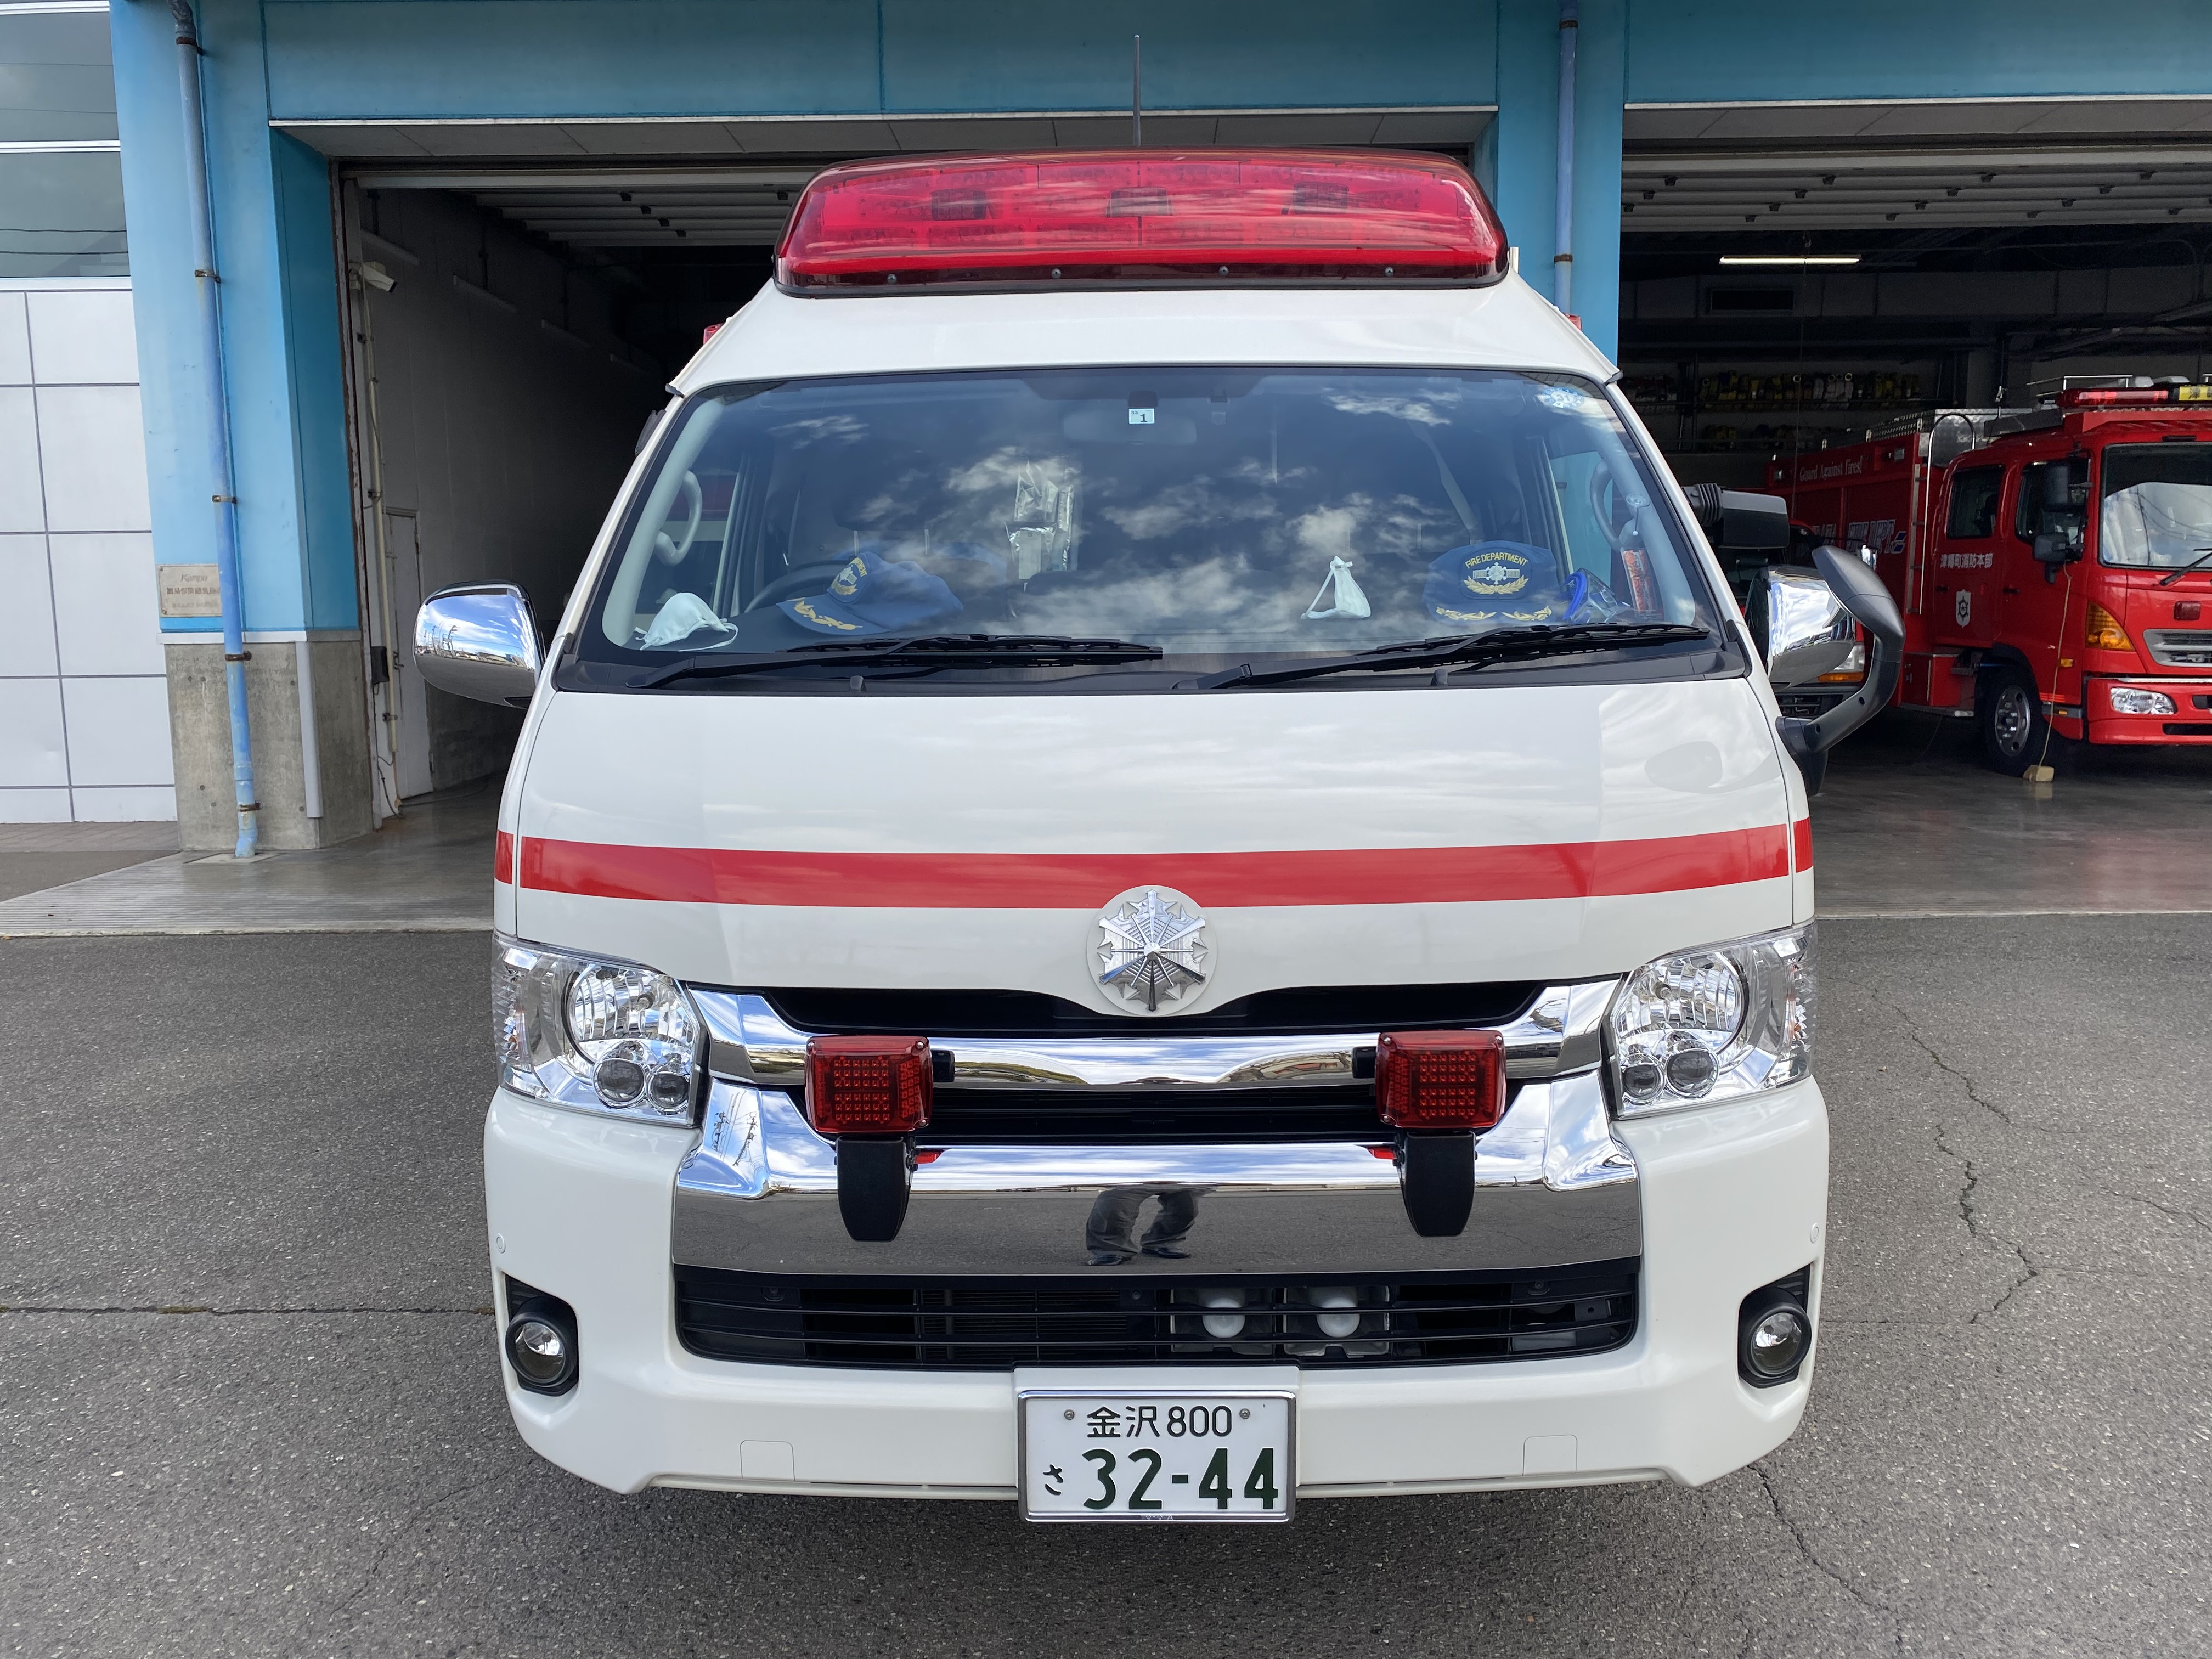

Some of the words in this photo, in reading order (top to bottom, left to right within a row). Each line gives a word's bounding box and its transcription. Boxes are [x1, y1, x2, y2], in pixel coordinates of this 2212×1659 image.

[1140, 414, 1148, 422] 1
[1799, 465, 1818, 482] Guard
[1819, 461, 1843, 481] Against
[1465, 555, 1482, 569] FIRE
[1481, 552, 1528, 566] DEPARTMENT
[1043, 1463, 1064, 1496] さ
[1082, 1448, 1278, 1510] 32-44
